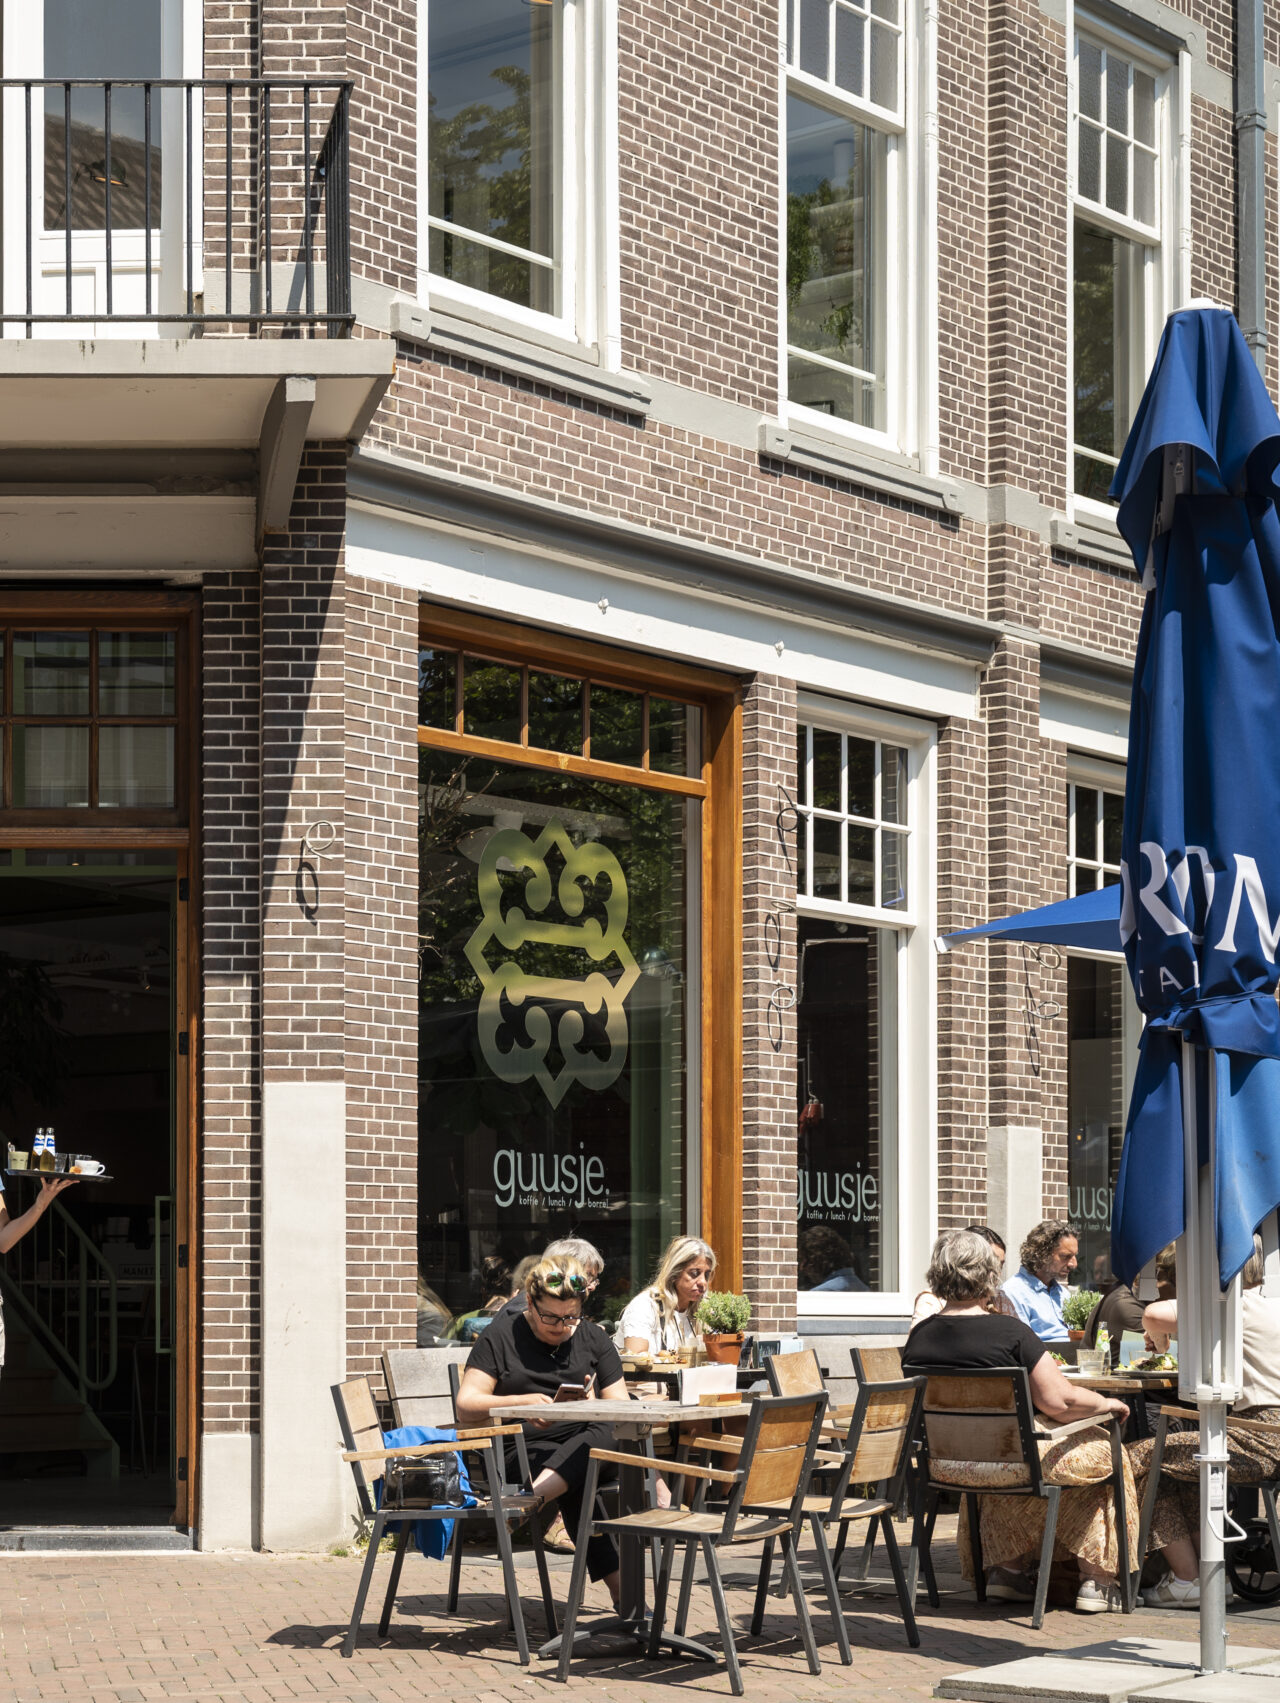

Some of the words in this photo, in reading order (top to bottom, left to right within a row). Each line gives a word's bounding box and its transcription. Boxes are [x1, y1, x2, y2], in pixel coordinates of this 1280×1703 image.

[519, 1195, 538, 1206] koffie
[542, 1197, 546, 1207] /
[548, 1195, 566, 1207] lunch
[588, 1197, 609, 1208] borrel
[806, 1209, 823, 1219] koffie
[830, 1210, 846, 1220] lunch
